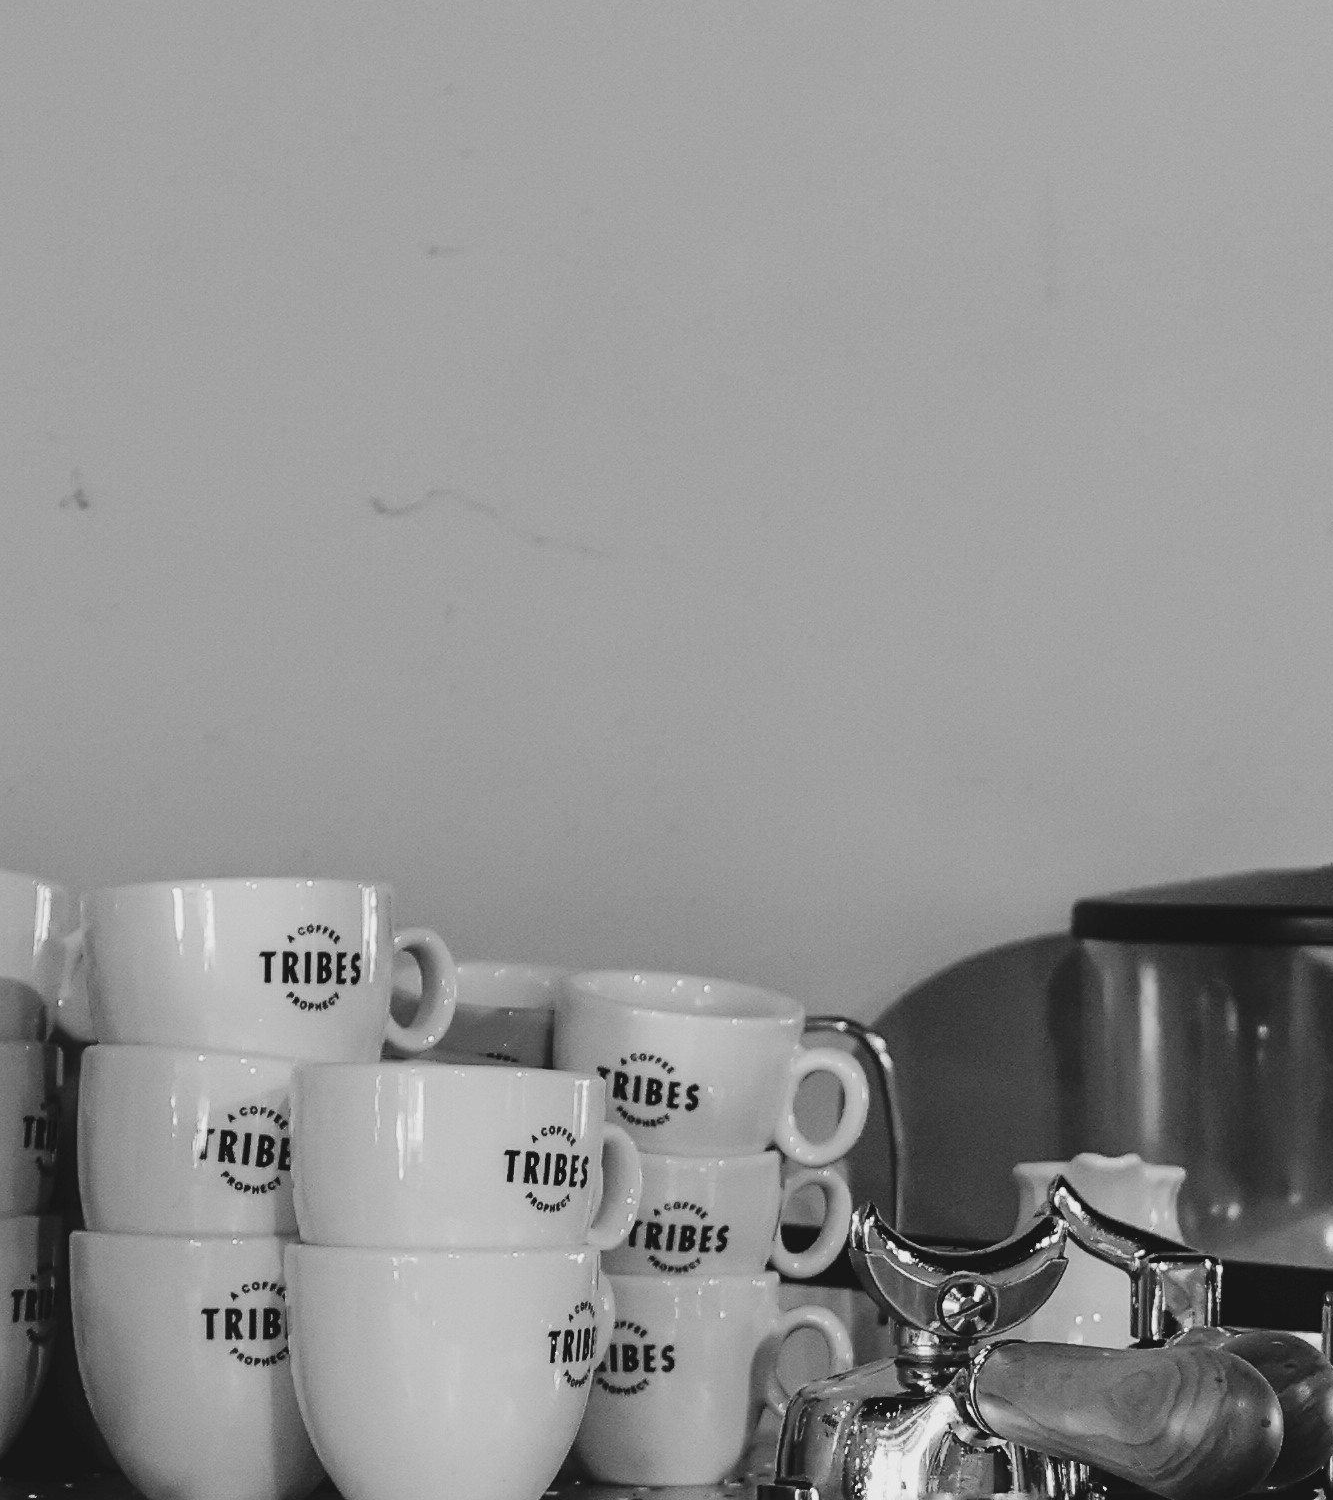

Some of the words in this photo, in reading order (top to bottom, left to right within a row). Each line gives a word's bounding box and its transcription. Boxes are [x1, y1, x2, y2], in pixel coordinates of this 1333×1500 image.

[287, 934, 296, 944] A
[297, 923, 341, 945] COFFEE
[259, 951, 361, 985] TRIBES
[285, 991, 340, 1012] PROPHECY
[239, 1105, 289, 1131] COFFEE
[199, 1128, 291, 1171] TRIBE
[531, 1134, 539, 1144] A
[540, 1125, 577, 1148] COFFEE
[504, 1149, 589, 1189] TRIBES
[525, 1191, 571, 1213] PROPHECY
[628, 1219, 730, 1253] TRIBES
[201, 1307, 288, 1341] TRIB
